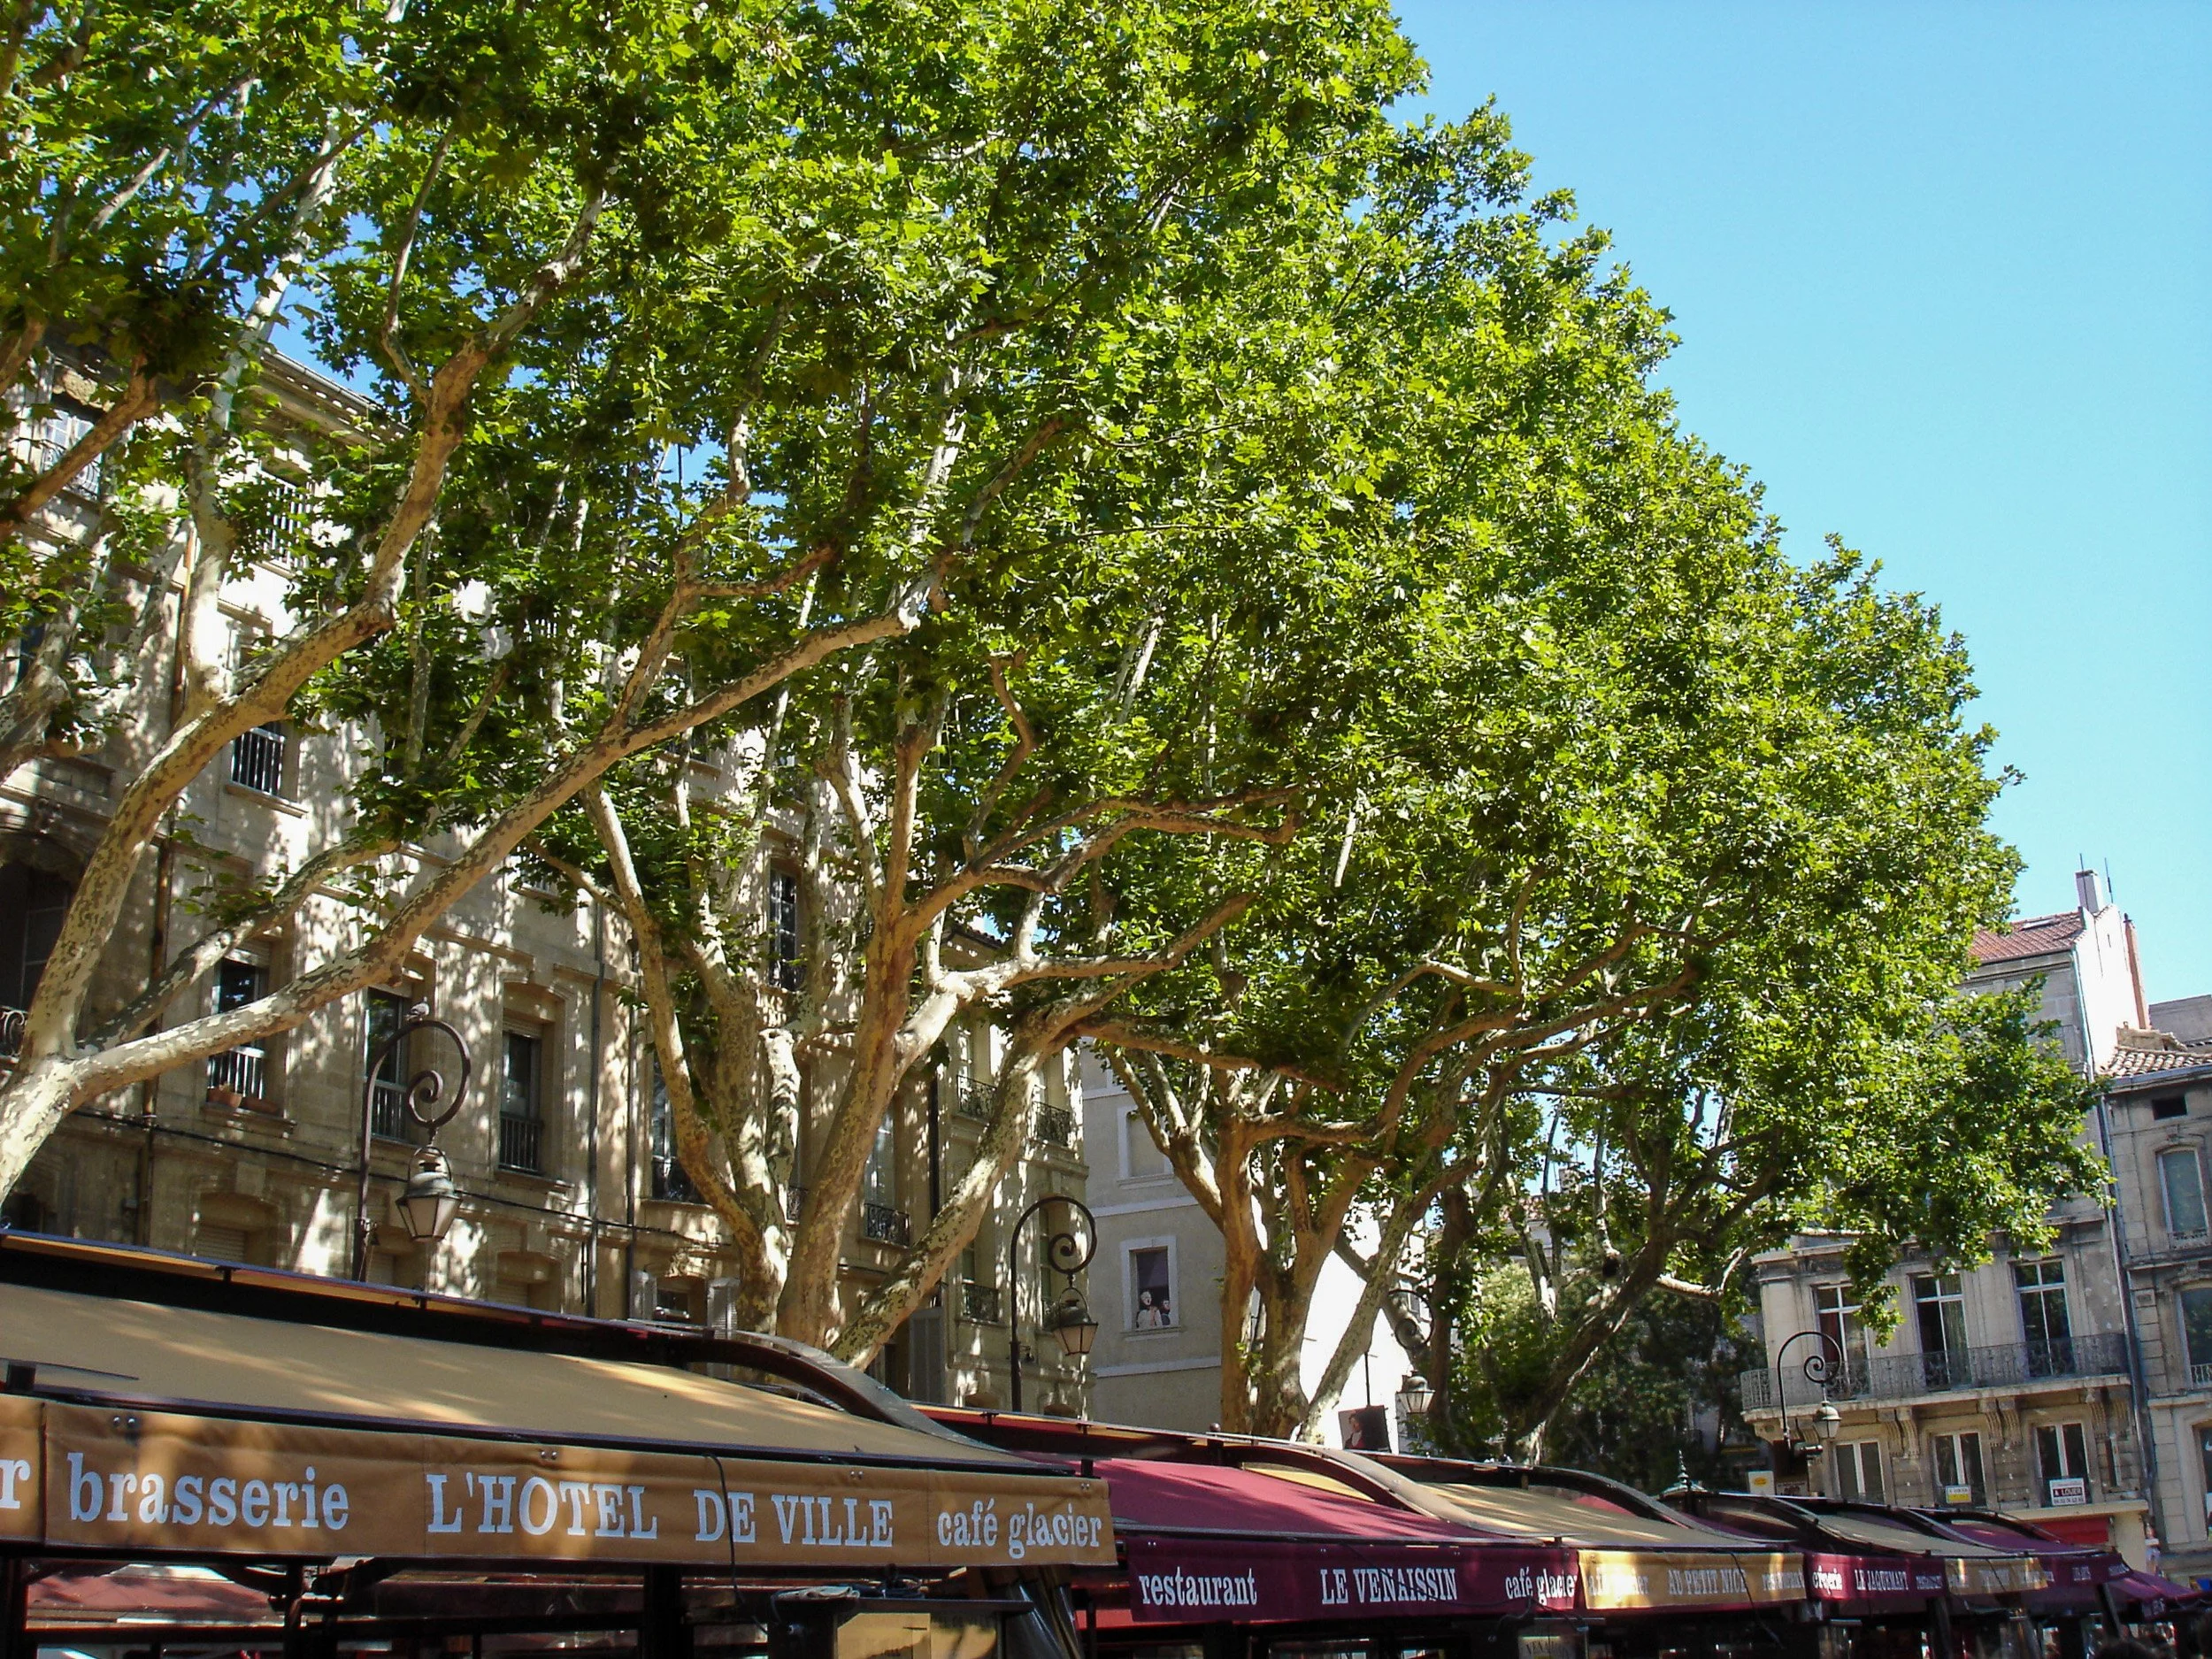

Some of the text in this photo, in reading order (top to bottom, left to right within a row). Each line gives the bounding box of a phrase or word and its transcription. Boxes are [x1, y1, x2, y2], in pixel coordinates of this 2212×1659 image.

[66, 1452, 349, 1530] brasserie
[426, 1471, 894, 1548] L'HOTEL DE VILLE
[937, 1497, 1103, 1559] café glacier
[1138, 1566, 1257, 1606] restaurant
[1320, 1567, 1458, 1605] LE VENAISSIN
[1505, 1566, 1533, 1600] café
[1668, 1569, 1684, 1595] AU
[1684, 1569, 1718, 1595] PETIT
[1720, 1568, 1748, 1594] NICE
